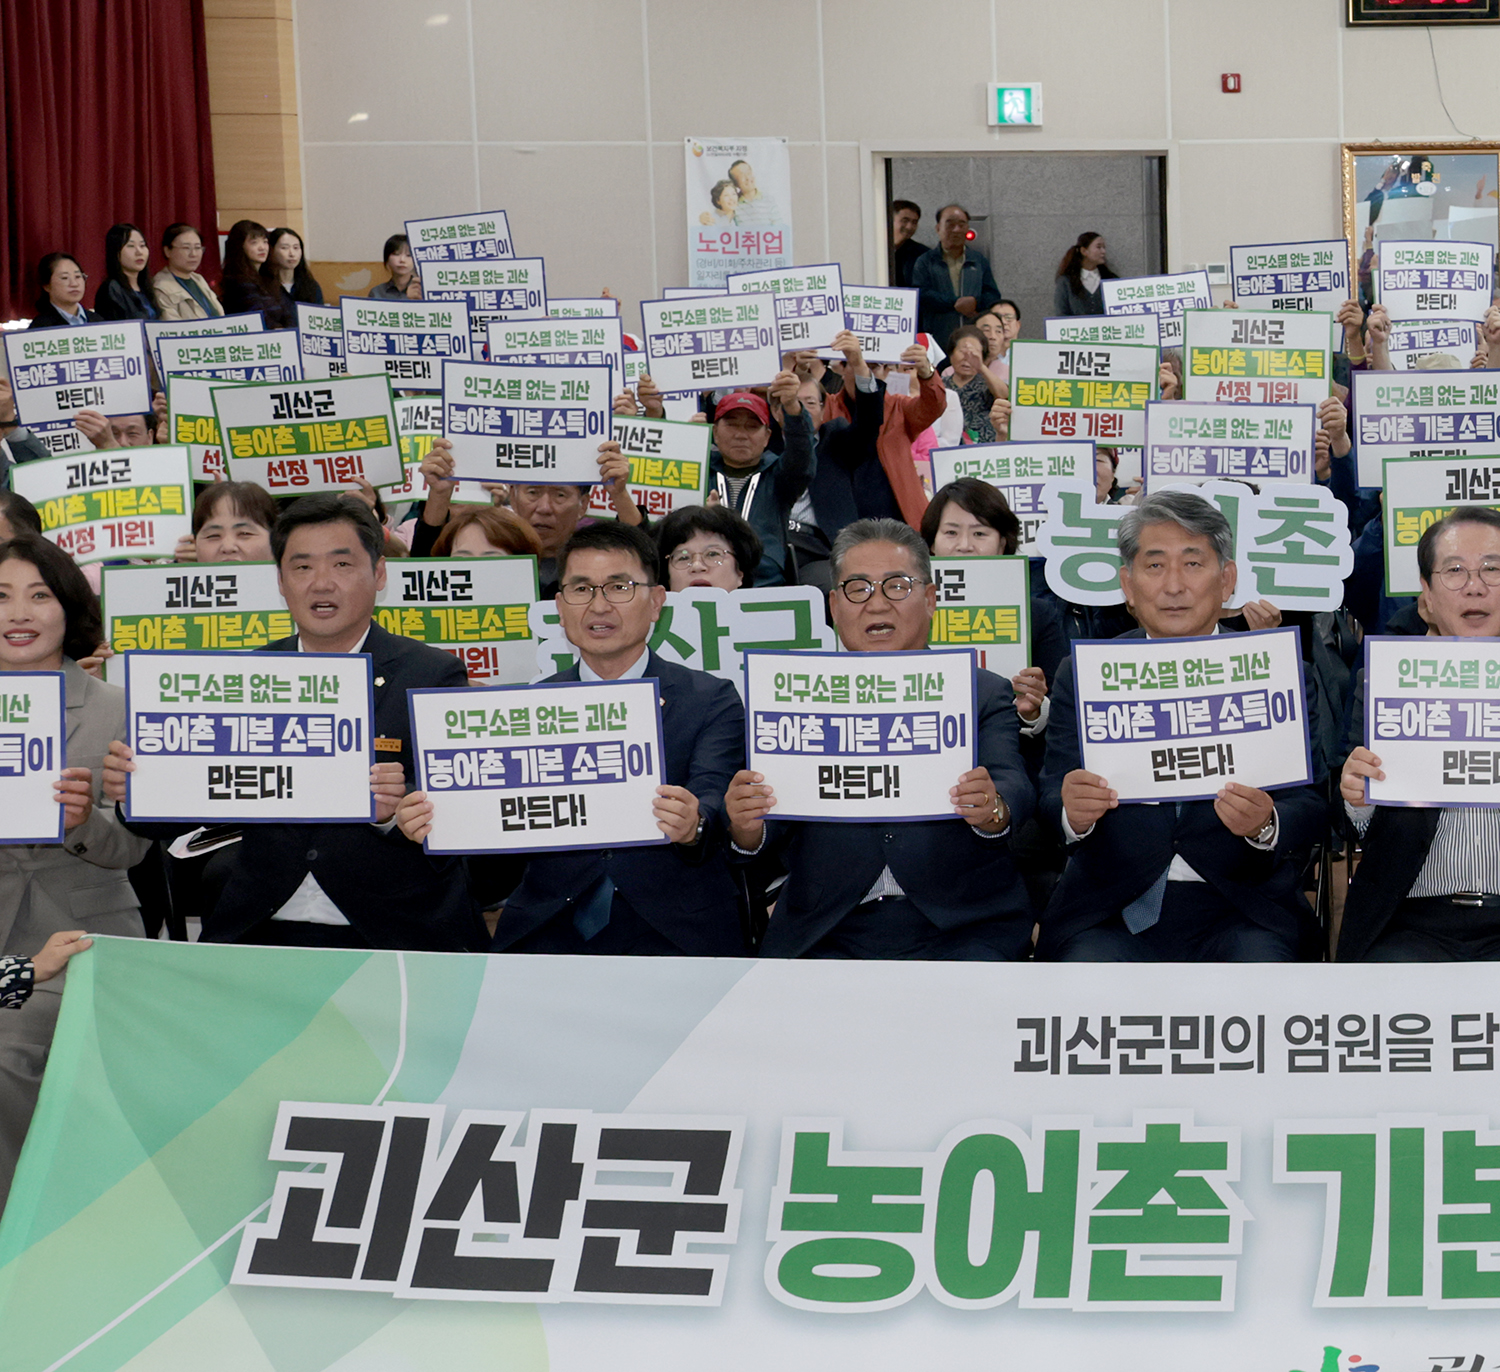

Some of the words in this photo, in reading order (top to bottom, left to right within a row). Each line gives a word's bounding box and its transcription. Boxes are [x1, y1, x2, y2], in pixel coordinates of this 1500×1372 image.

[697, 230, 782, 255] 노인취업
[660, 309, 706, 328] 인구소멸
[710, 308, 732, 324] 없는
[736, 305, 758, 321] 괴산
[651, 333, 694, 356] 농어촌
[696, 331, 726, 352] 기본
[730, 327, 774, 349] 소득이
[691, 357, 738, 379] 만든다!
[1058, 351, 1110, 376] 괴산군
[270, 390, 335, 419] 괴산군
[1018, 380, 1072, 406] 농어촌
[1077, 382, 1148, 408] 기본소득
[230, 425, 296, 457] 농어촌
[300, 418, 388, 451] 기본소득
[1041, 412, 1076, 436] 선정
[1083, 413, 1123, 437] 기원!
[268, 460, 309, 487] 선정
[313, 456, 364, 483] 기원!
[160, 673, 243, 702] 인구소멸
[250, 674, 291, 703] 없는
[298, 675, 339, 703] 괴산
[774, 673, 849, 703] 인구소멸
[856, 675, 896, 703] 없는
[904, 672, 944, 701] 괴산
[1102, 660, 1178, 691] 인구소멸
[1183, 659, 1224, 687] 없는
[1230, 652, 1270, 682] 괴산
[1398, 659, 1479, 688] 인구소멸
[445, 708, 530, 738] 인구소멸
[536, 706, 578, 735] 없는
[585, 702, 627, 731] 괴산
[1087, 702, 1155, 740] 농어촌
[1160, 700, 1212, 735] 기본
[1219, 689, 1296, 730] 소득이
[1377, 700, 1451, 737] 농어촌
[138, 715, 215, 752] 농어촌
[222, 716, 274, 752] 기본
[281, 717, 361, 752] 소득이
[757, 715, 824, 752] 농어촌
[831, 717, 880, 752] 기본
[888, 714, 966, 751] 소득이
[428, 750, 505, 788] 농어촌
[511, 748, 564, 783] 기본
[572, 742, 652, 780] 소득이
[1151, 744, 1234, 782] 만든다!
[208, 765, 292, 800] 만든다!
[819, 765, 900, 799] 만든다!
[500, 794, 586, 831] 만든다!
[1013, 1014, 1265, 1075] 괴산군민의
[1283, 1013, 1434, 1073] 염원을
[247, 1116, 732, 1296] 괴산군
[778, 1123, 1231, 1303] 농어촌
